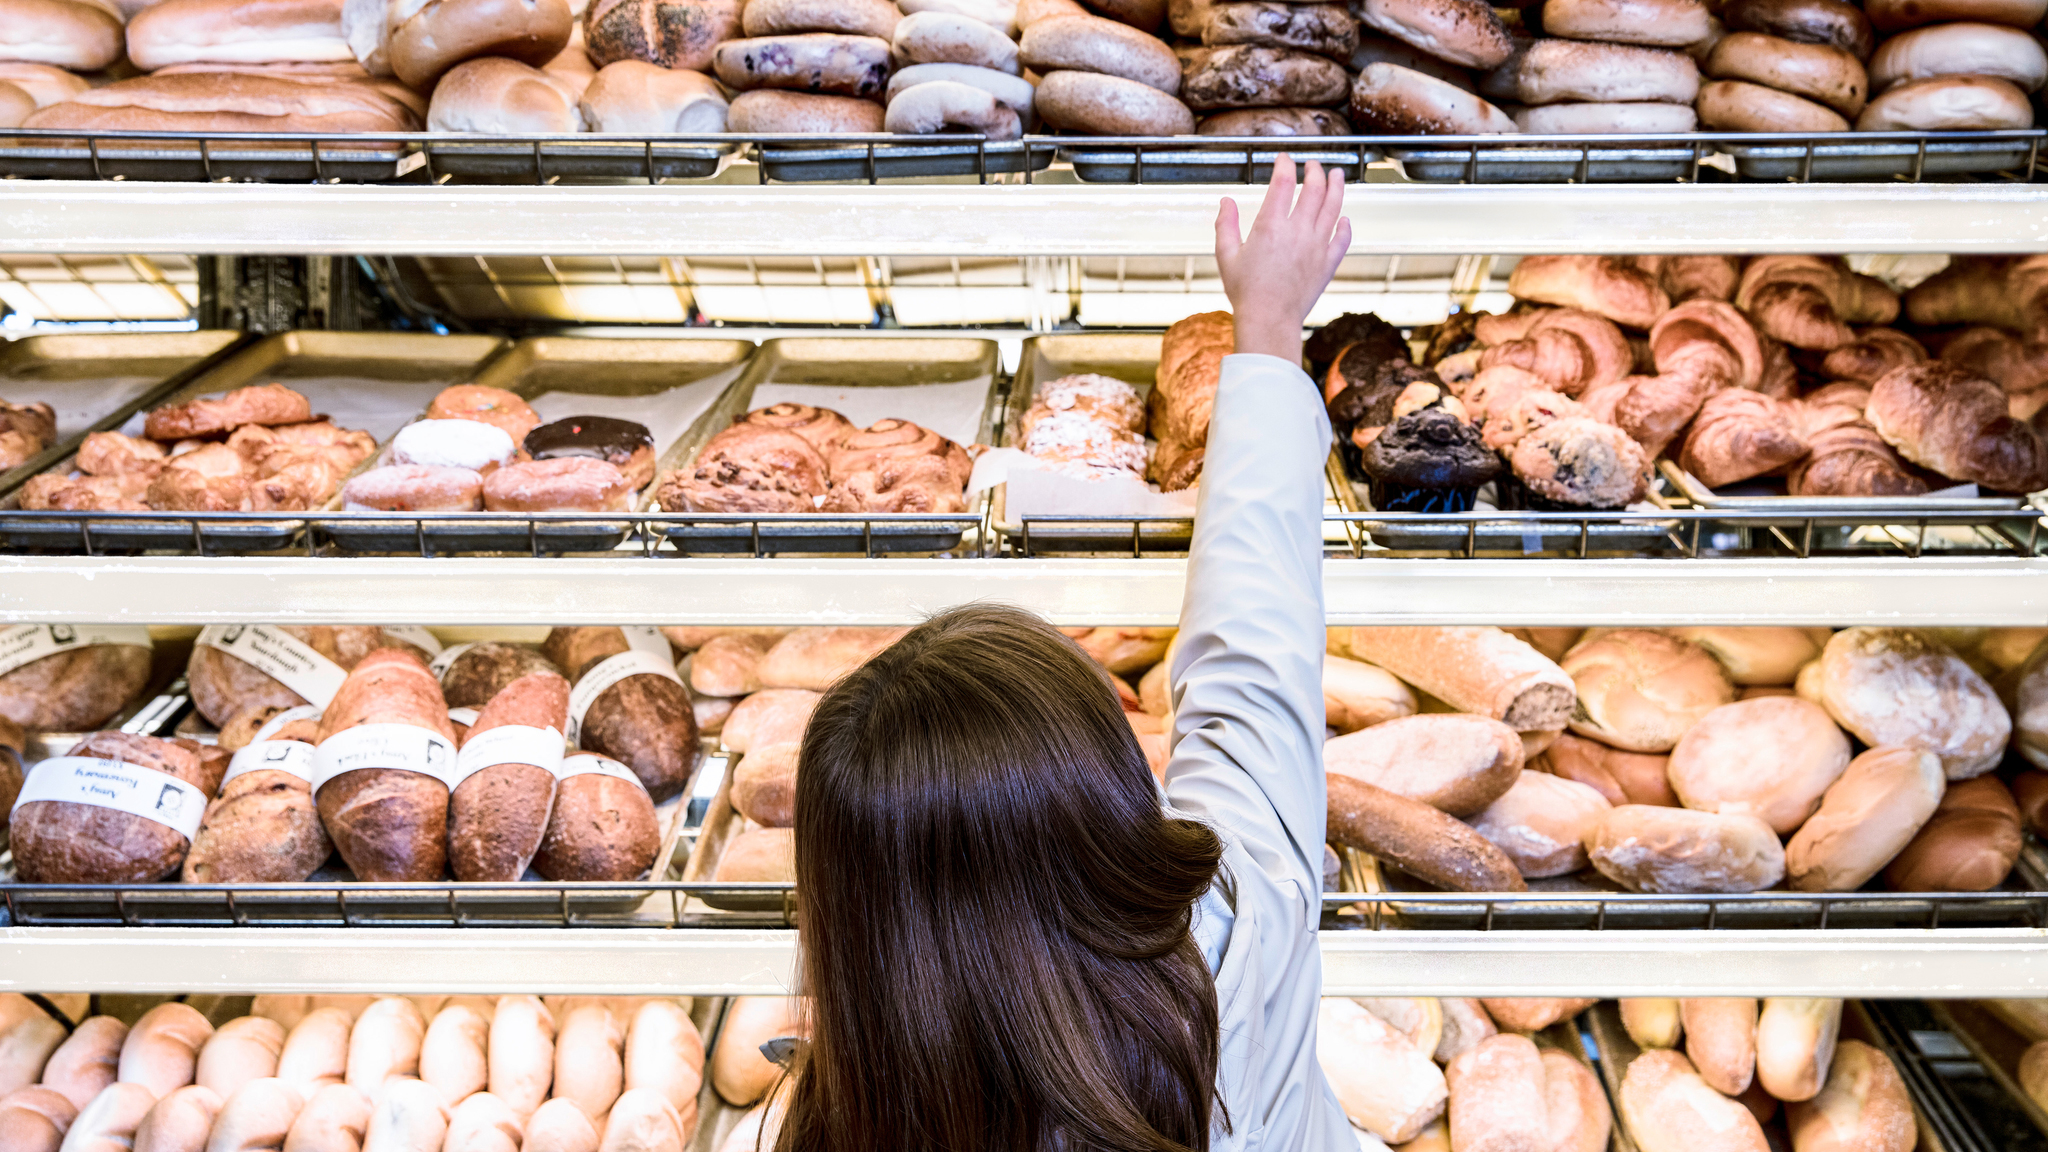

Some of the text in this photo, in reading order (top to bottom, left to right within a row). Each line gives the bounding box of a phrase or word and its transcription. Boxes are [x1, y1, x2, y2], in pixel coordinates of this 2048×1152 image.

[250, 640, 299, 674] Sourdough
[277, 639, 317, 670] Country
[74, 767, 139, 788] Rosemary
[81, 784, 119, 799] Amy's
